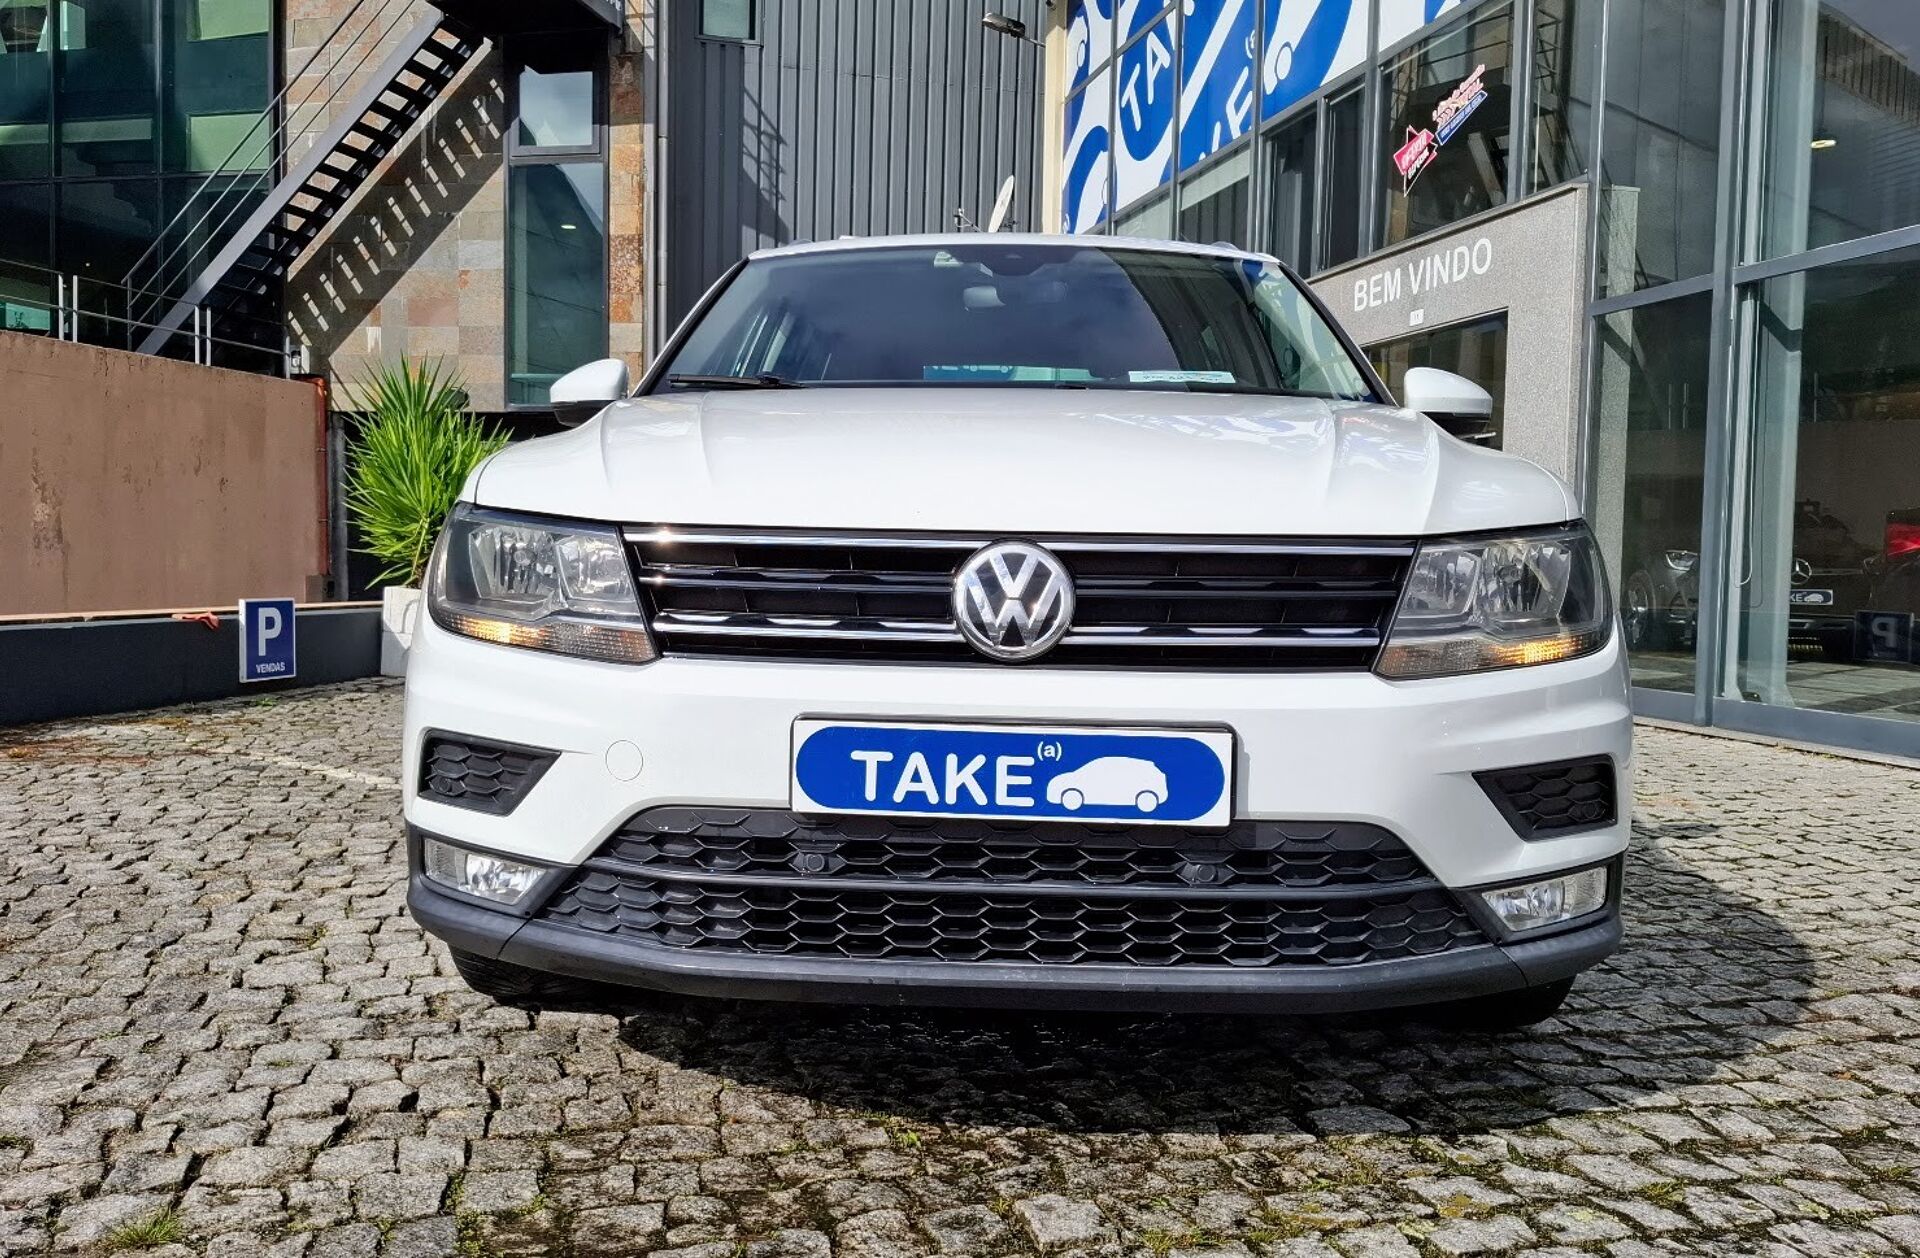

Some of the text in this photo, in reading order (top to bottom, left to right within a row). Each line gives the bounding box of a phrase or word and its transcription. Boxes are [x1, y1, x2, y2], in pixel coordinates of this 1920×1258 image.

[1354, 238, 1492, 312] BEM VINDO
[258, 607, 282, 656] P
[256, 662, 286, 673] VENDAS
[850, 751, 1035, 807] TAKE
